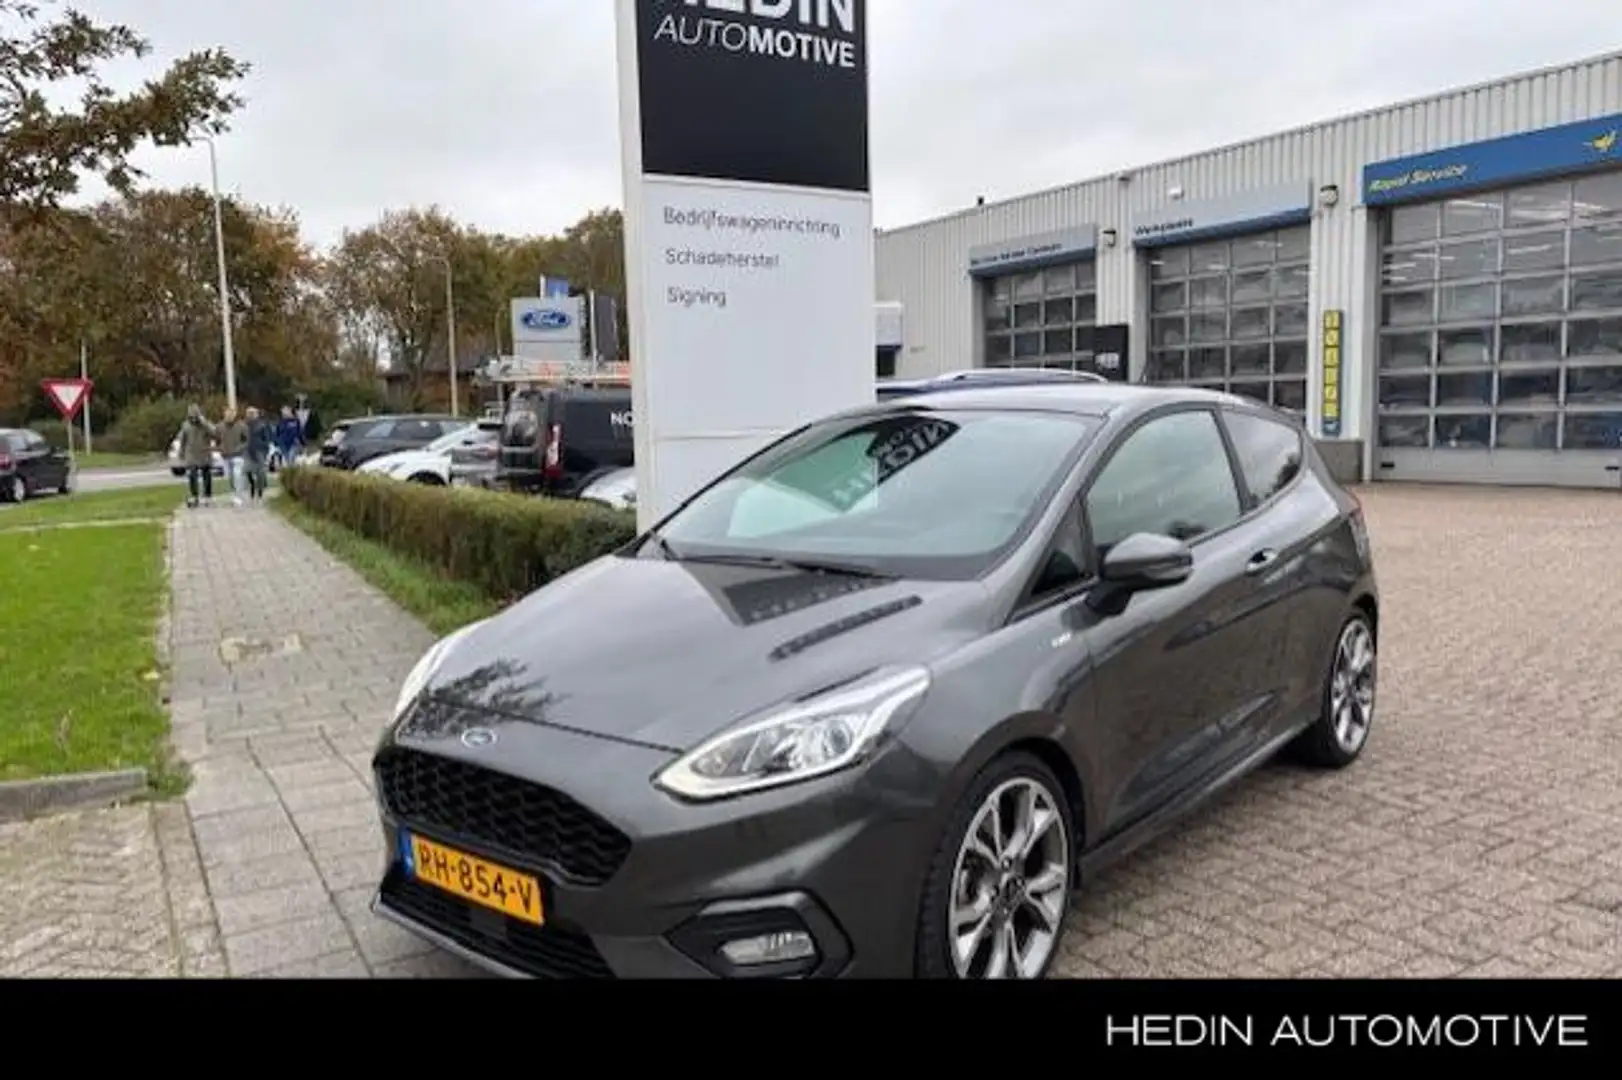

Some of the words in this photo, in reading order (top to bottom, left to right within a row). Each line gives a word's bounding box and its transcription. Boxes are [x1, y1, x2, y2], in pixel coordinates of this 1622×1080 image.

[683, 0, 855, 33] DIN
[654, 14, 855, 67] AUTOMOTIVE
[665, 247, 779, 267] Schadeherstel
[667, 286, 727, 308] Signing
[417, 842, 533, 914] RH-854-V
